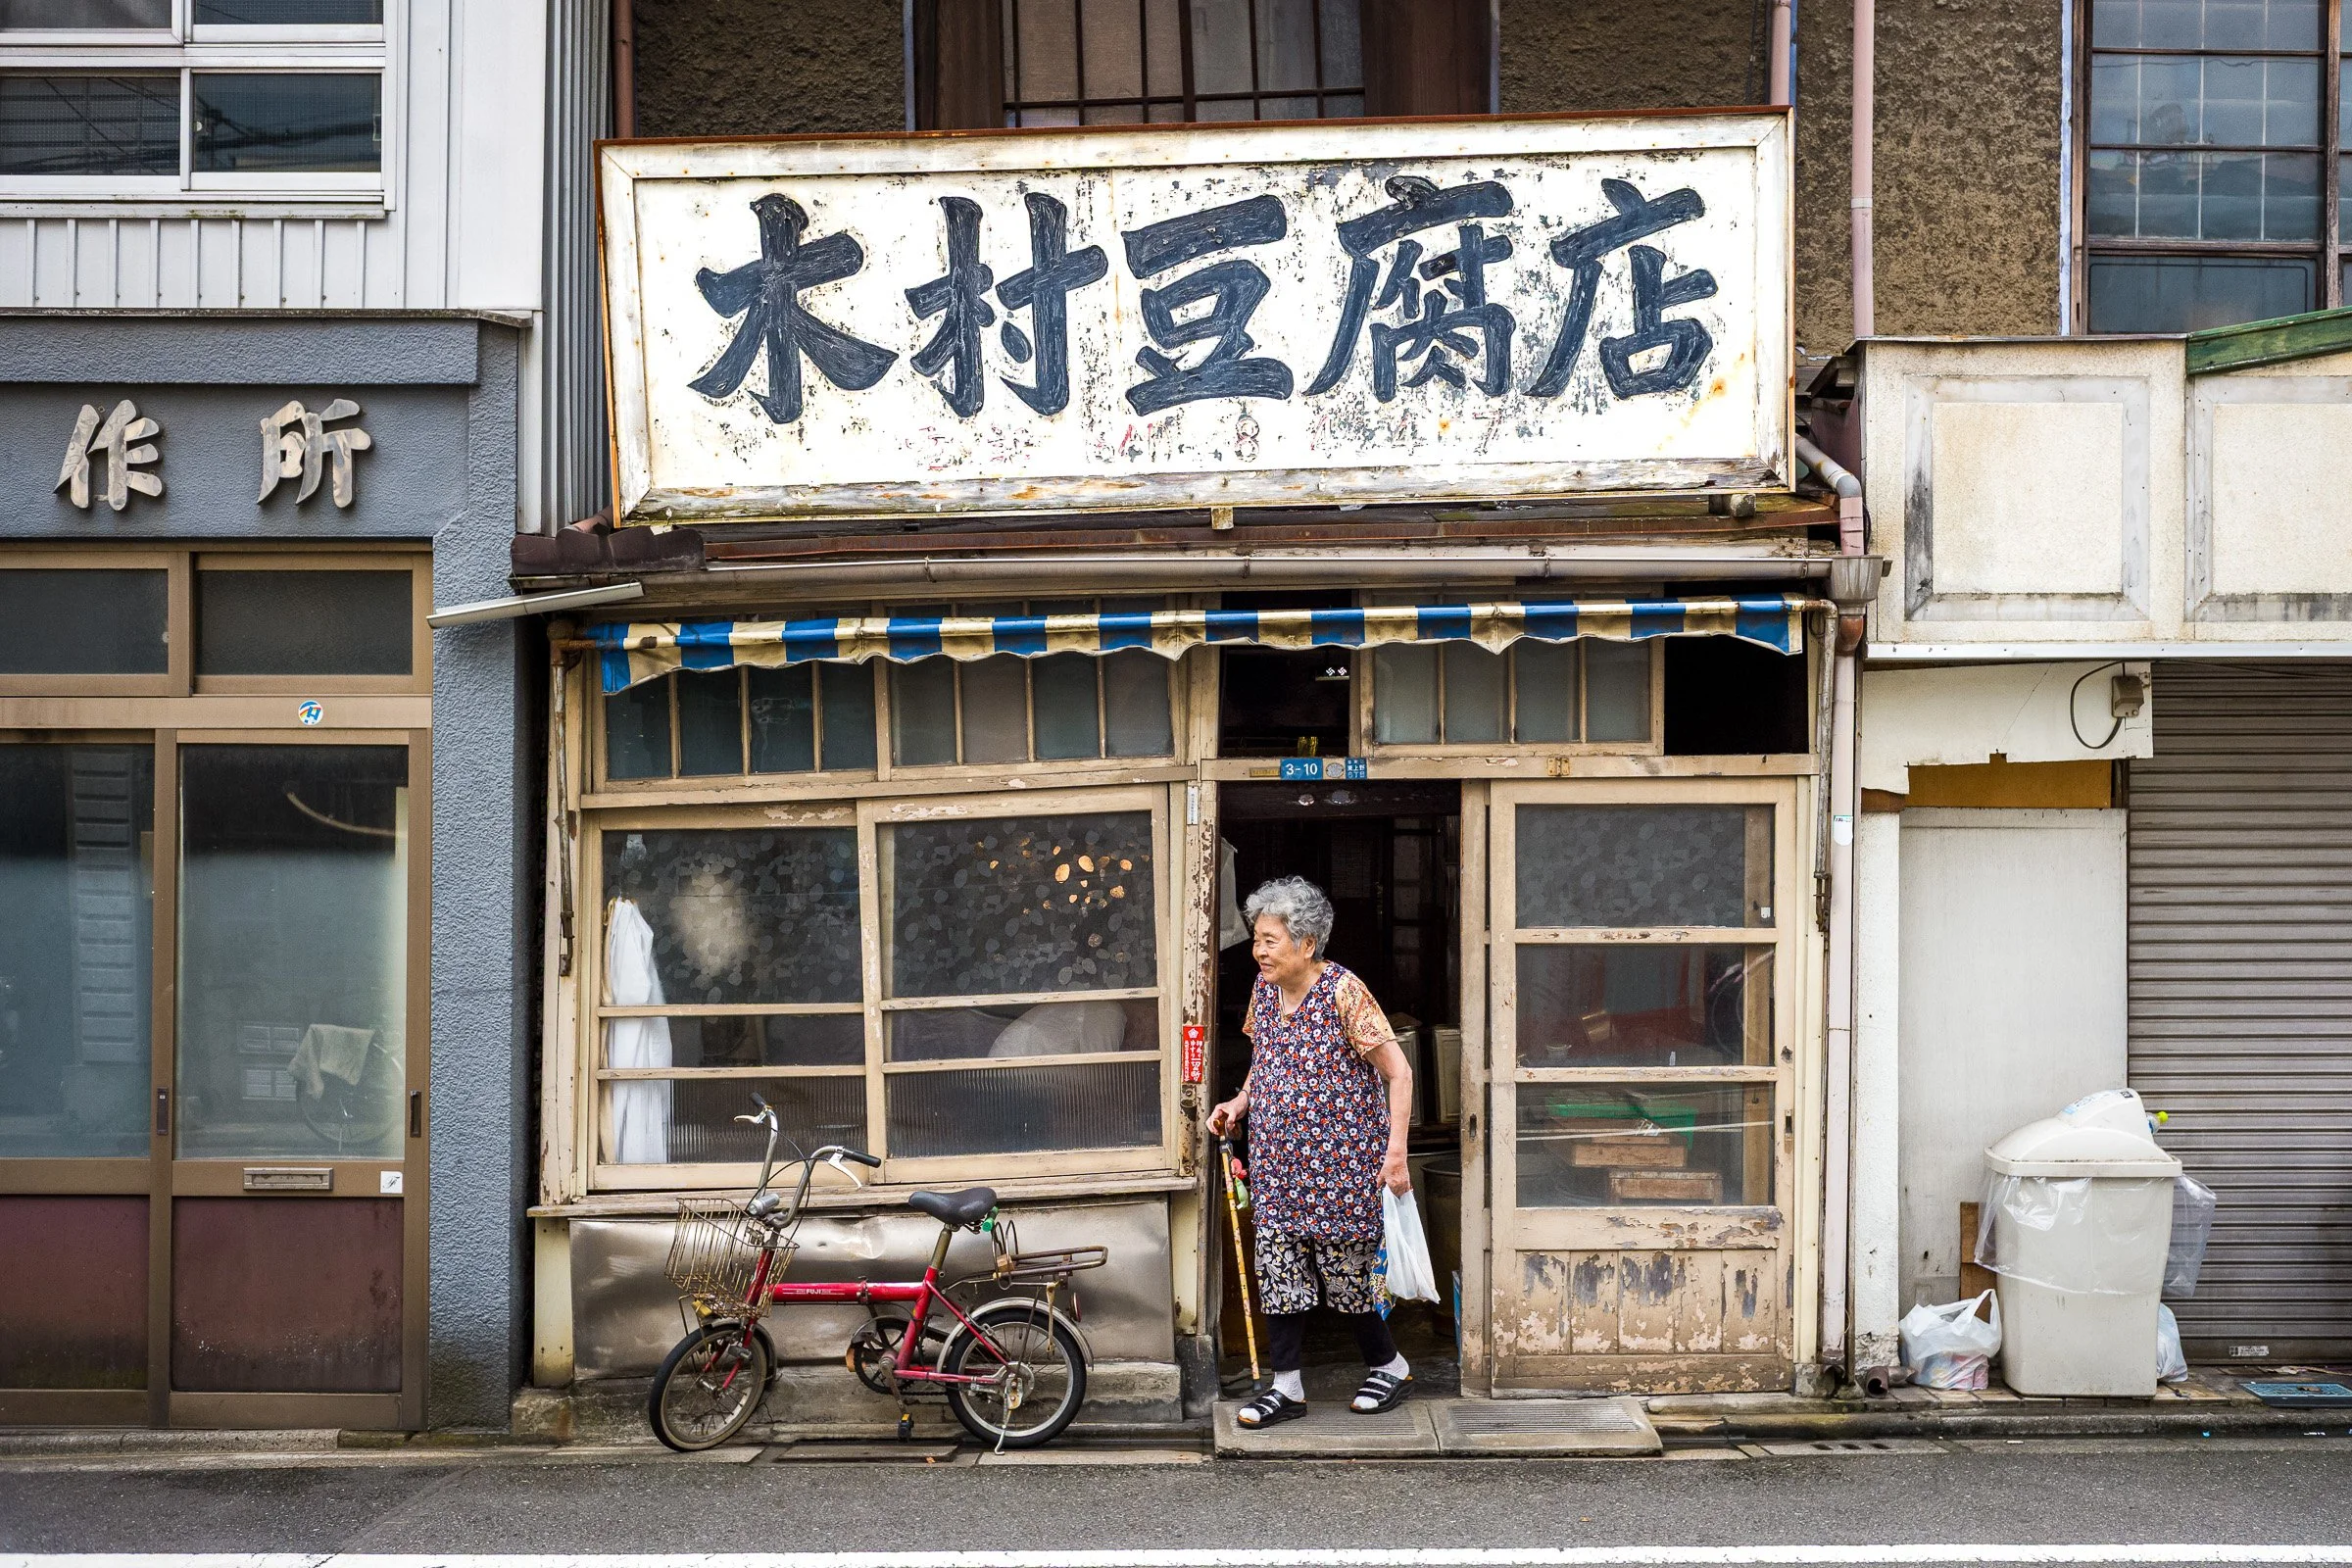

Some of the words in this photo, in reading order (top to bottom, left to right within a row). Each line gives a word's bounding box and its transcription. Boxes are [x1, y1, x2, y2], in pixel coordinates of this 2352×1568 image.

[687, 175, 1717, 424] 木村豆腐店
[55, 398, 372, 511] 作所
[1285, 762, 1318, 775] 3-10
